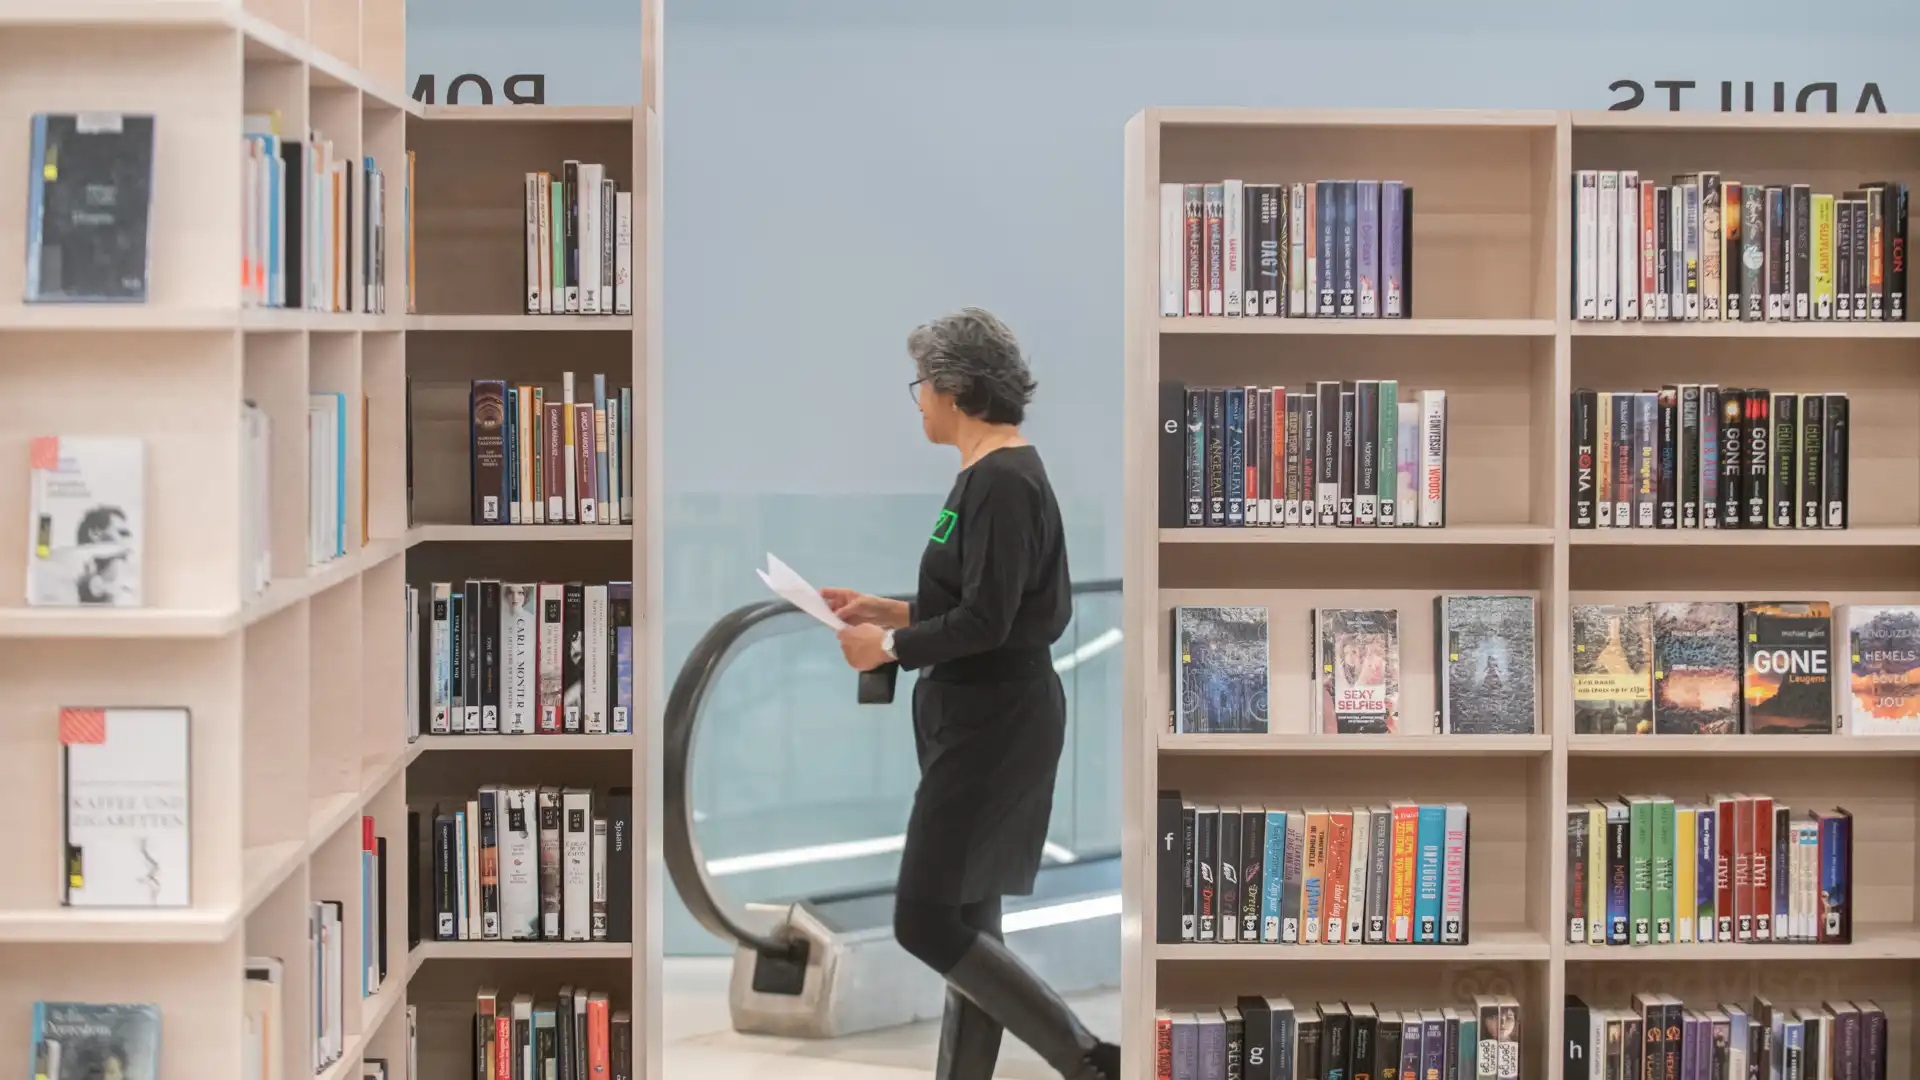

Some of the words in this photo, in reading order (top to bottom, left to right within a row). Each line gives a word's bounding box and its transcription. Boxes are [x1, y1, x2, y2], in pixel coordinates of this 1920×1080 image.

[1260, 240, 1278, 267] DAG
[1893, 237, 1904, 274] EON
[1260, 268, 1278, 278] 7
[1164, 419, 1178, 434] e
[1429, 419, 1442, 457] UNIVERSUM
[1212, 438, 1223, 498] ANGELFAL
[1726, 427, 1740, 476] GONE
[1751, 427, 1767, 476] GONE
[1231, 439, 1243, 499] ANGELFAL
[1578, 445, 1592, 493] EONA
[516, 618, 525, 658] CARLA
[1753, 649, 1828, 674] GONE
[1865, 650, 1916, 661] HEMELS
[516, 661, 525, 709] MONTER
[1343, 690, 1375, 700] SEXY
[1789, 674, 1826, 684] Leugens
[1872, 673, 1909, 684] BOVEN
[1337, 700, 1384, 711] SELFIES
[1875, 696, 1905, 707] JOU
[614, 819, 625, 853] Spaans
[1164, 832, 1175, 851] f
[1422, 845, 1438, 900] UNPLUGGED
[1635, 856, 1647, 891] HALF
[1656, 856, 1668, 891] HALF
[1717, 854, 1729, 889] HALF
[1735, 852, 1748, 885] HALF
[1754, 852, 1767, 887] HALF
[1248, 1046, 1265, 1065] g
[1479, 1041, 1491, 1074] george
[1498, 1043, 1510, 1076] george
[1569, 1039, 1583, 1060] h
